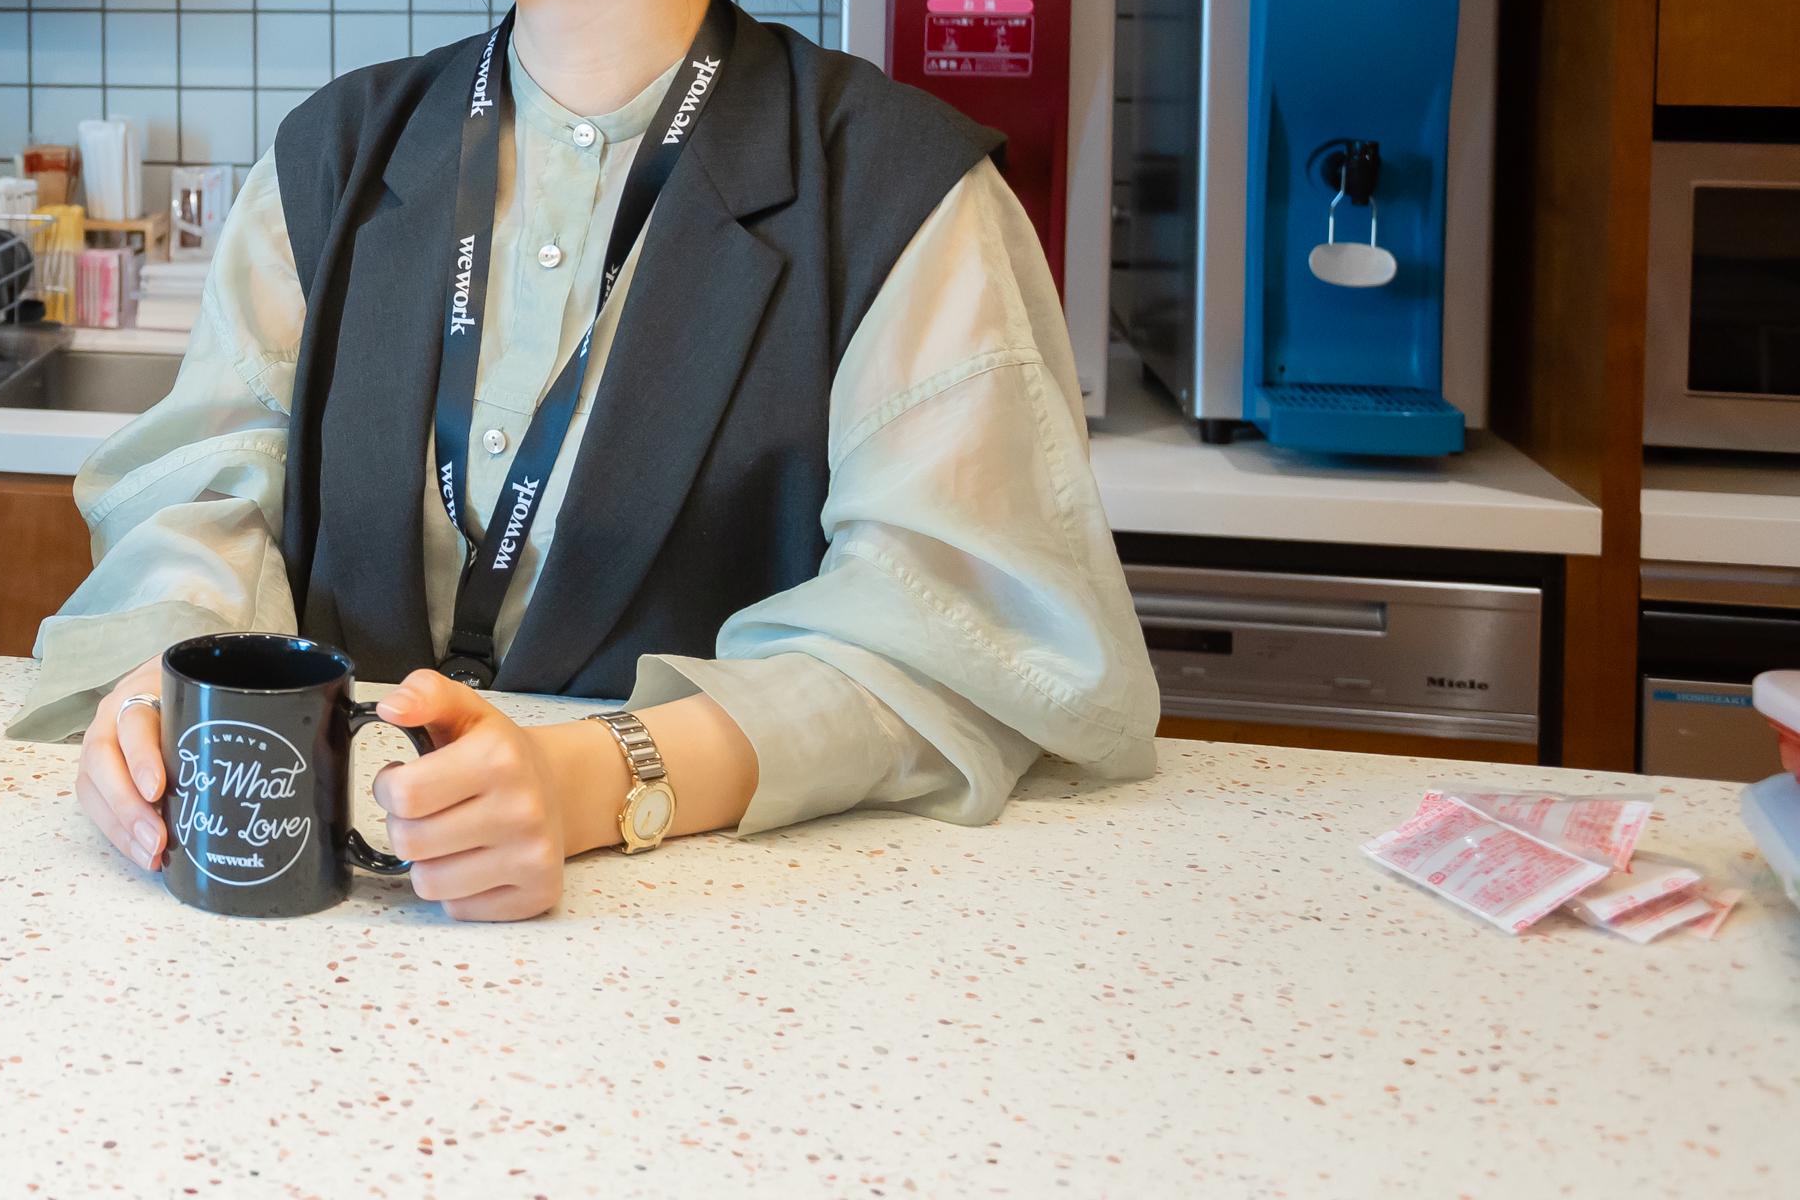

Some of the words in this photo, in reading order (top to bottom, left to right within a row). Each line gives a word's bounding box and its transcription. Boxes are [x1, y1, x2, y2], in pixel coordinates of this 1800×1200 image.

[661, 55, 721, 146] wework
[450, 233, 476, 336] wework
[492, 475, 540, 570] wework
[1426, 676, 1489, 691] Miele
[204, 733, 268, 751] ALWAYS
[178, 748, 217, 793] Do
[212, 759, 298, 800] What
[175, 786, 229, 847] You
[237, 801, 305, 847] Love
[205, 851, 265, 869] wework
